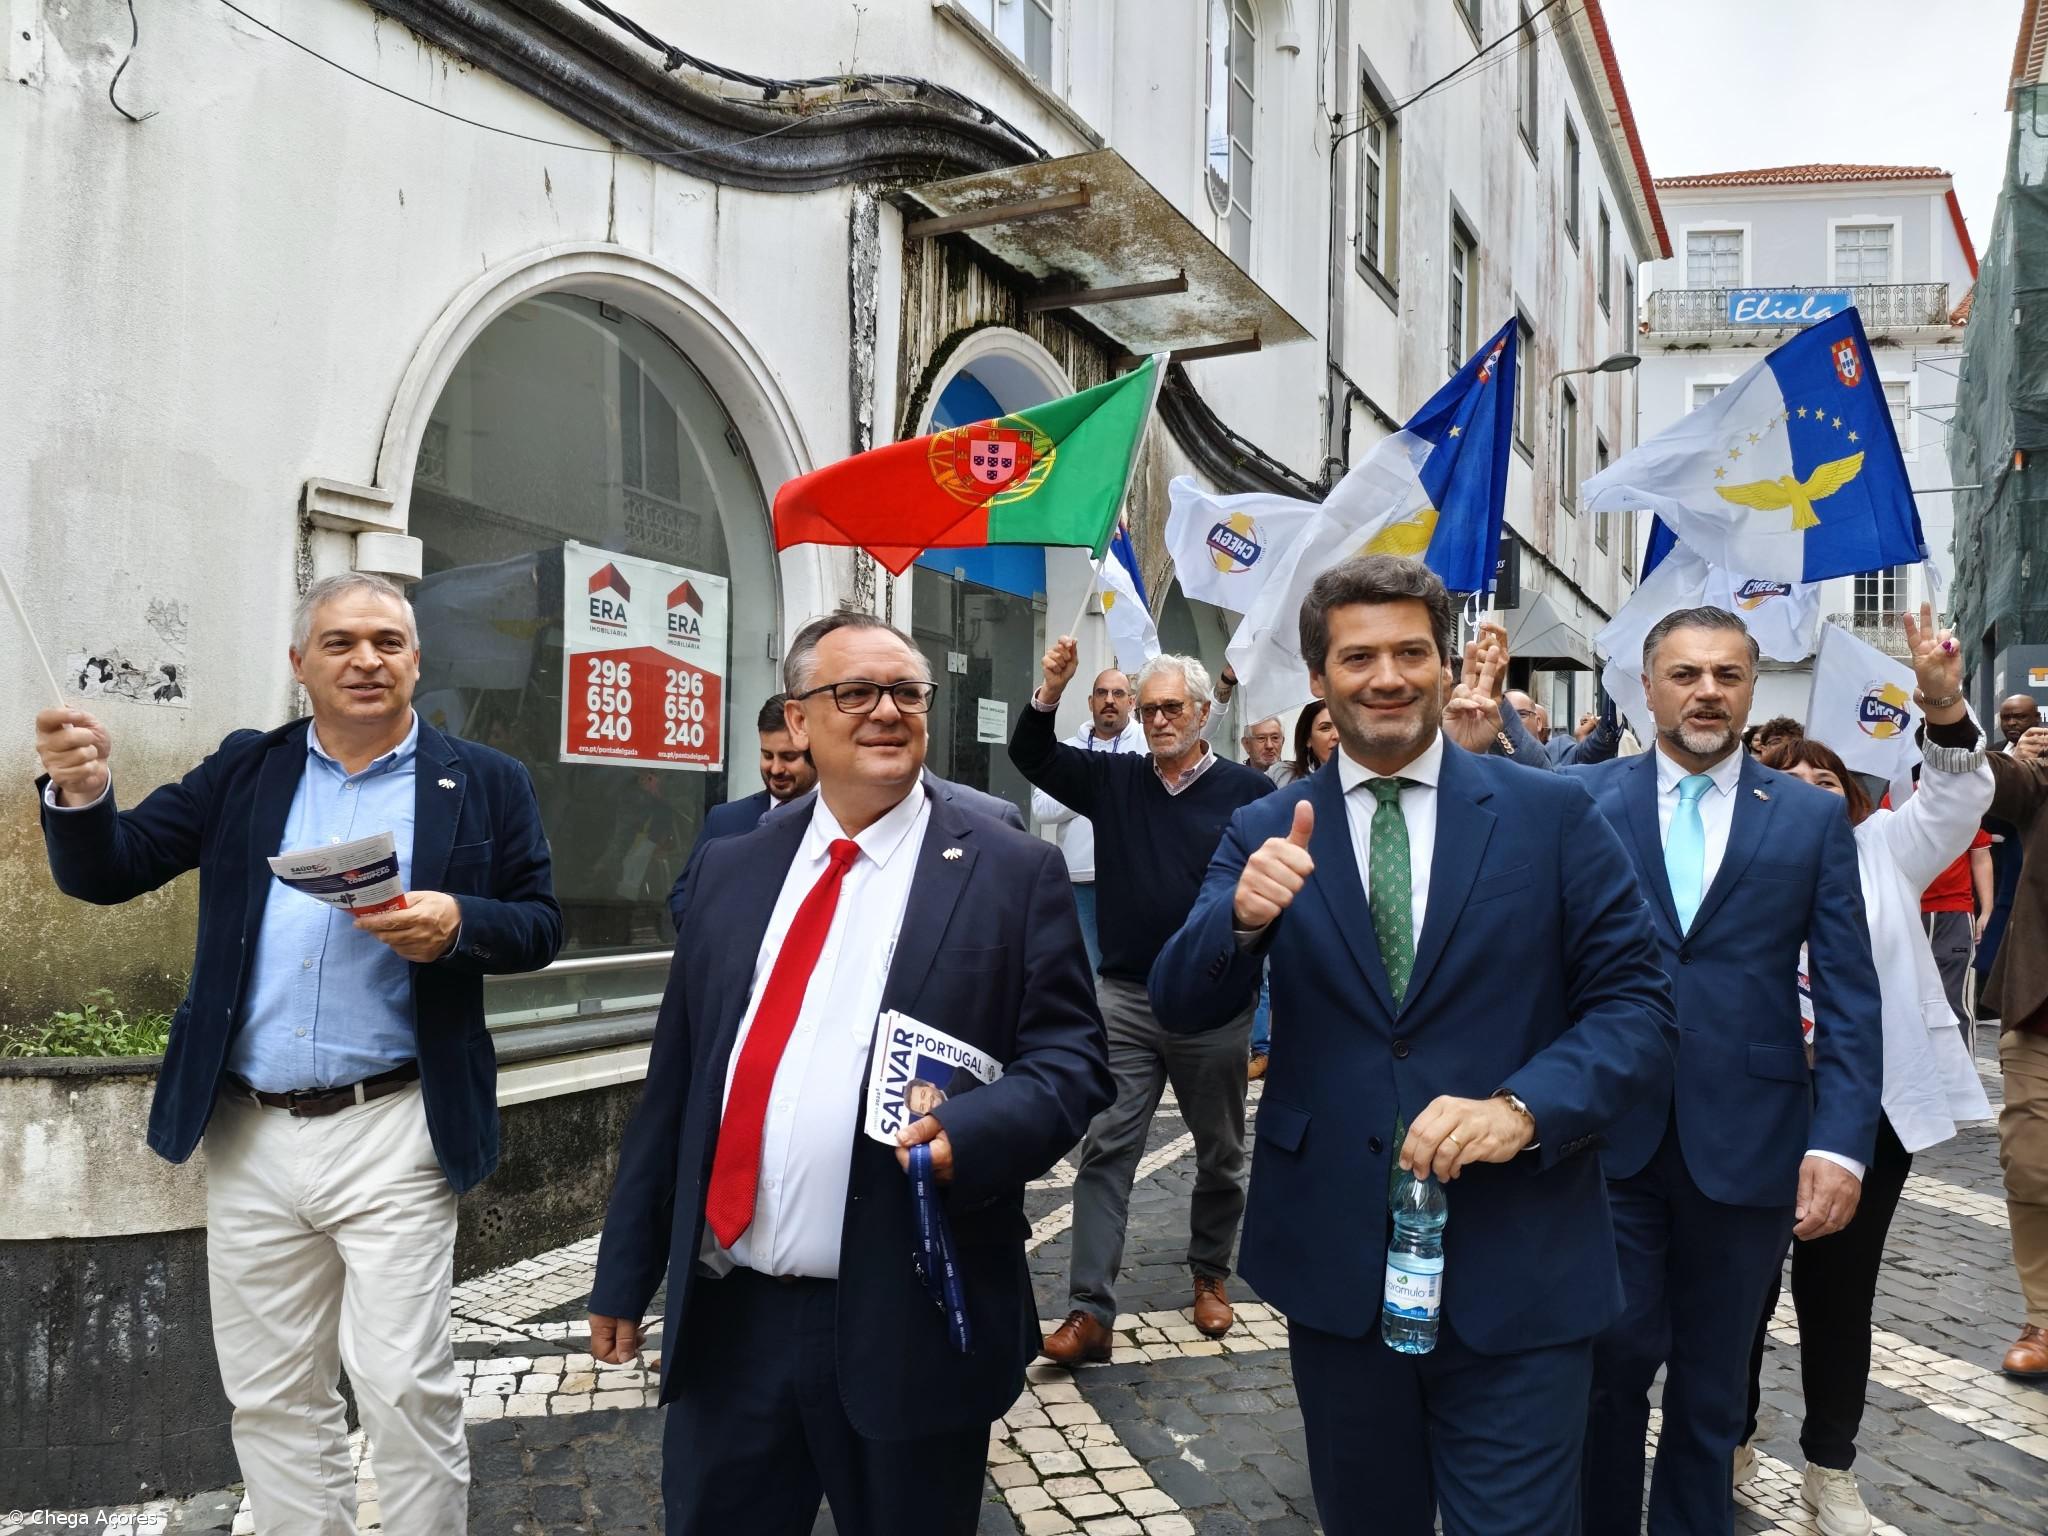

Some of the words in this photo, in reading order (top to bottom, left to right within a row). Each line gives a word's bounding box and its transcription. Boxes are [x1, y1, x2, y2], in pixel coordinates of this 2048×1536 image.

[590, 597, 627, 623] ERA
[589, 625, 628, 638] IMOBILIÁRIA
[668, 613, 700, 636] ERA
[667, 639, 701, 650] IMOBILIÁRIA
[588, 657, 632, 688] 296
[665, 669, 704, 697] 296
[587, 685, 632, 715] 650
[664, 695, 705, 722] 650
[586, 713, 632, 742] 240
[663, 720, 705, 748] 240
[578, 745, 639, 757] era.pt/pontadelgada
[657, 751, 711, 761] era.pt/pontadelgada
[915, 1033, 983, 1074] PORTUGAL
[880, 1028, 915, 1137] SALVAR
